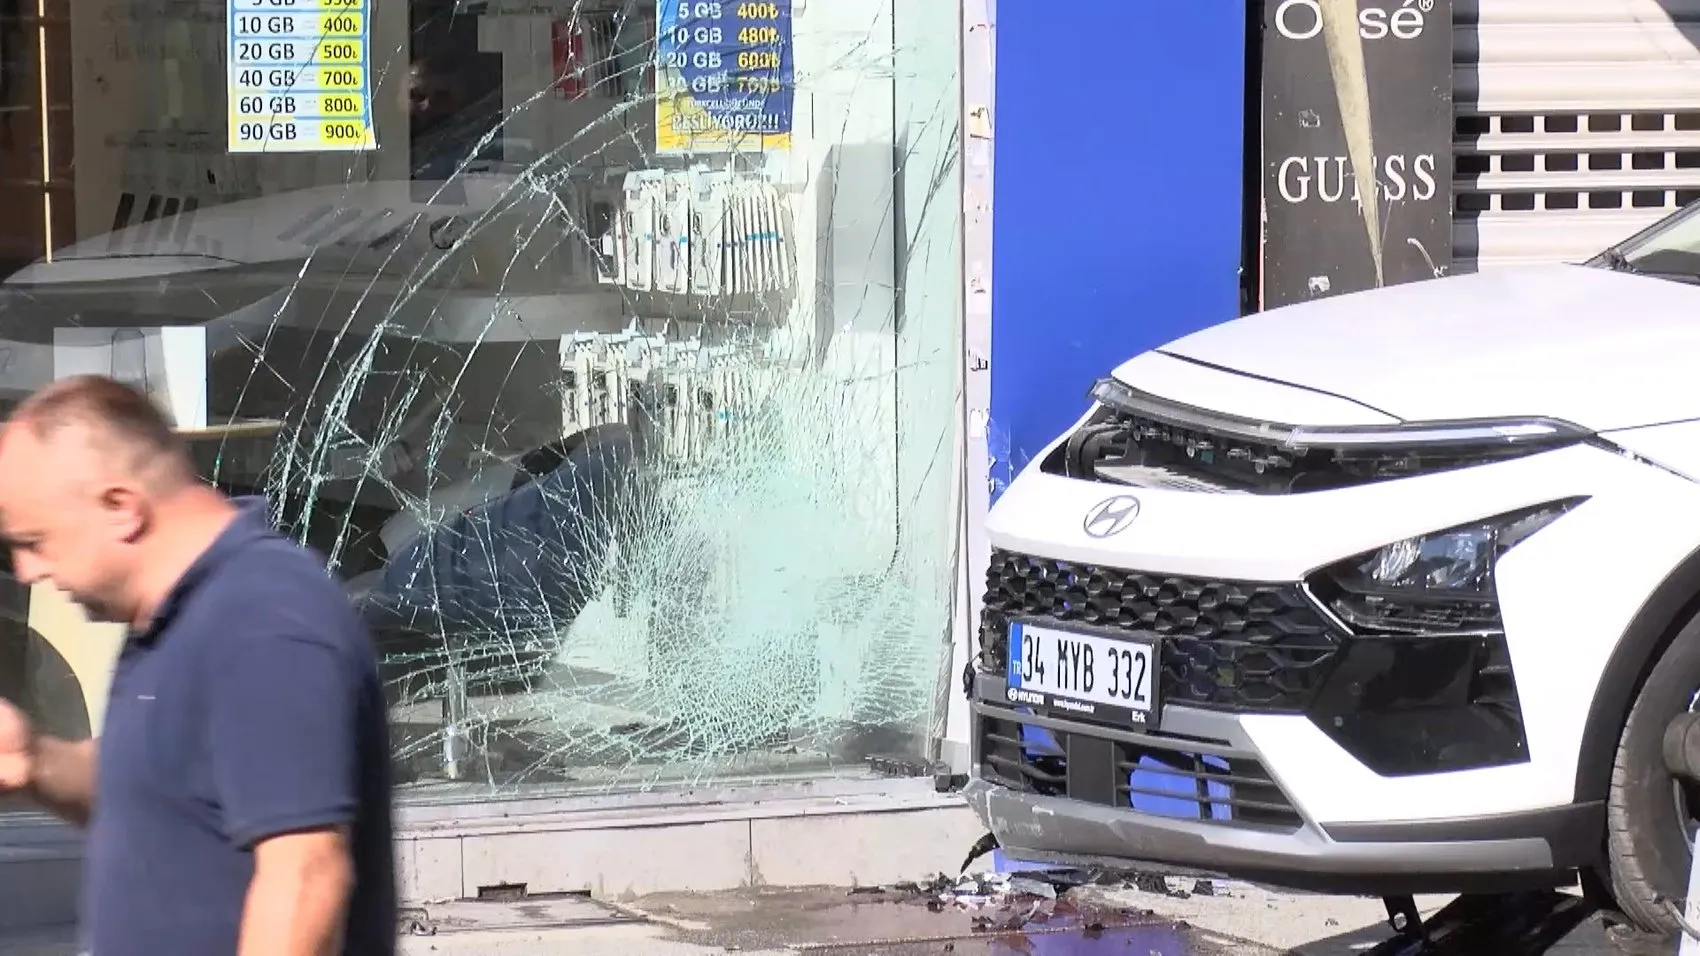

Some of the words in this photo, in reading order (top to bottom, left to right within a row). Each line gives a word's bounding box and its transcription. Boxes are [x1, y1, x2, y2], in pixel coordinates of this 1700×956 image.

[678, 3, 690, 18] 5
[694, 3, 722, 18] GB
[239, 16, 261, 34] 10
[268, 16, 294, 34] GB
[669, 27, 689, 44] 10
[694, 27, 722, 44] GB
[239, 43, 262, 61] 20
[268, 43, 295, 61] GB
[667, 52, 688, 68] 20
[693, 52, 722, 68] GB
[239, 69, 263, 87] 40
[269, 69, 295, 87] GB
[240, 96, 263, 114] 60
[269, 96, 296, 114] GB
[240, 123, 264, 140] 90
[269, 123, 297, 140] GB
[1277, 153, 1436, 204] GUSS
[1012, 660, 1022, 675] TR
[1023, 634, 1045, 685] 34
[1057, 638, 1094, 693] MYB
[1107, 647, 1146, 703] 332
